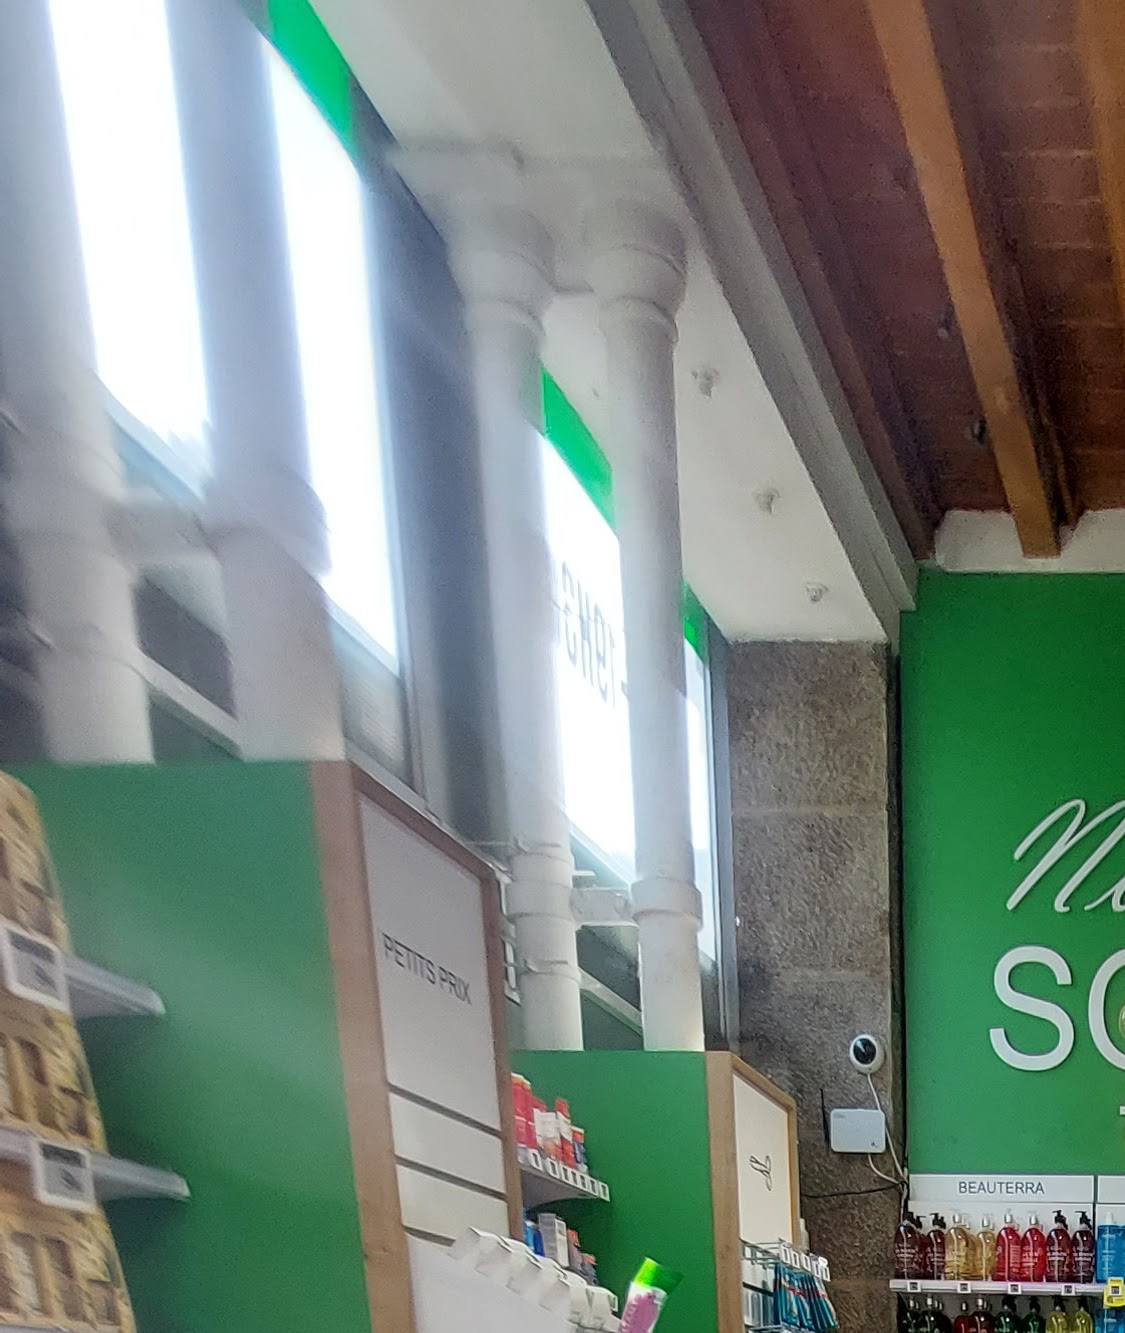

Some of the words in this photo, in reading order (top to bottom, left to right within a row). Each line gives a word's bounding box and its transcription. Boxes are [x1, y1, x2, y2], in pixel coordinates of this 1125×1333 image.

[379, 930, 437, 985] PETITS
[438, 964, 473, 1006] PRIX
[957, 1180, 1046, 1197] BEAUTERRA
